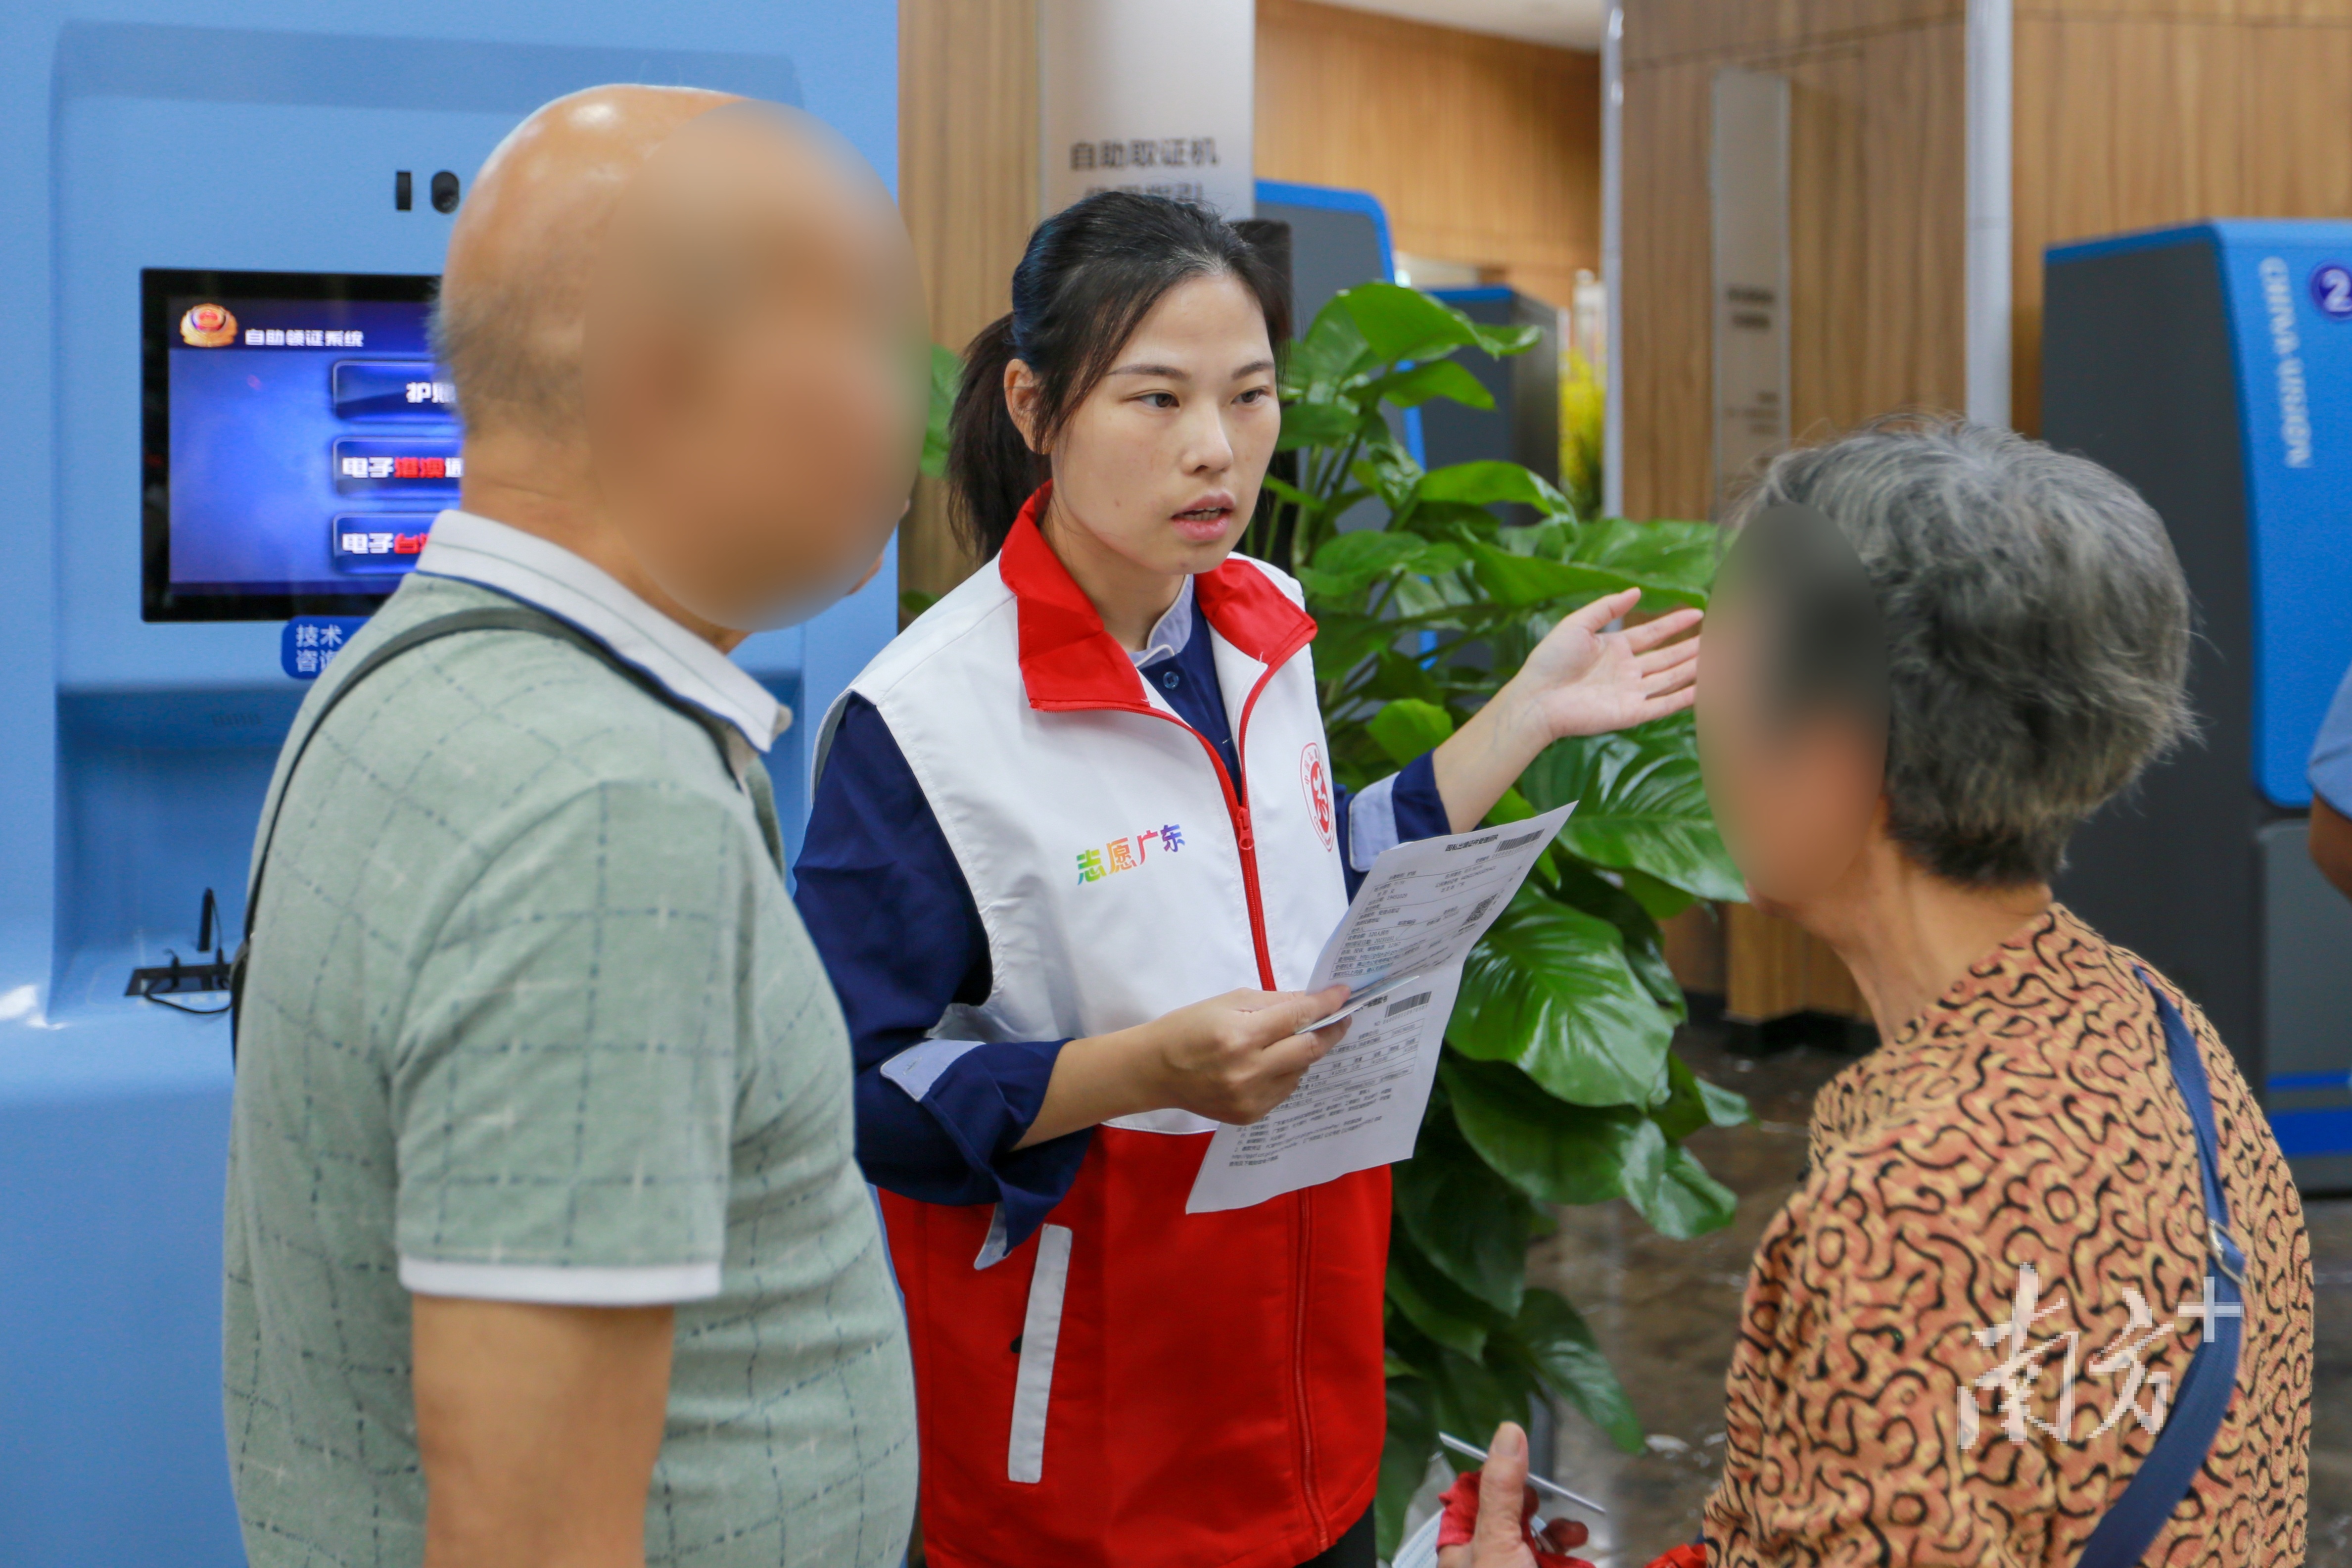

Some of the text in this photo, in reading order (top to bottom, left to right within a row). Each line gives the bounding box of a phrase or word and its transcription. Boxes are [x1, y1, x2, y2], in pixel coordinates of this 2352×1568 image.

[1070, 137, 1219, 171] 自助取证机
[245, 329, 364, 347] 自助领证系统
[296, 623, 343, 648] 技术
[1076, 823, 1186, 886] 志愿广东
